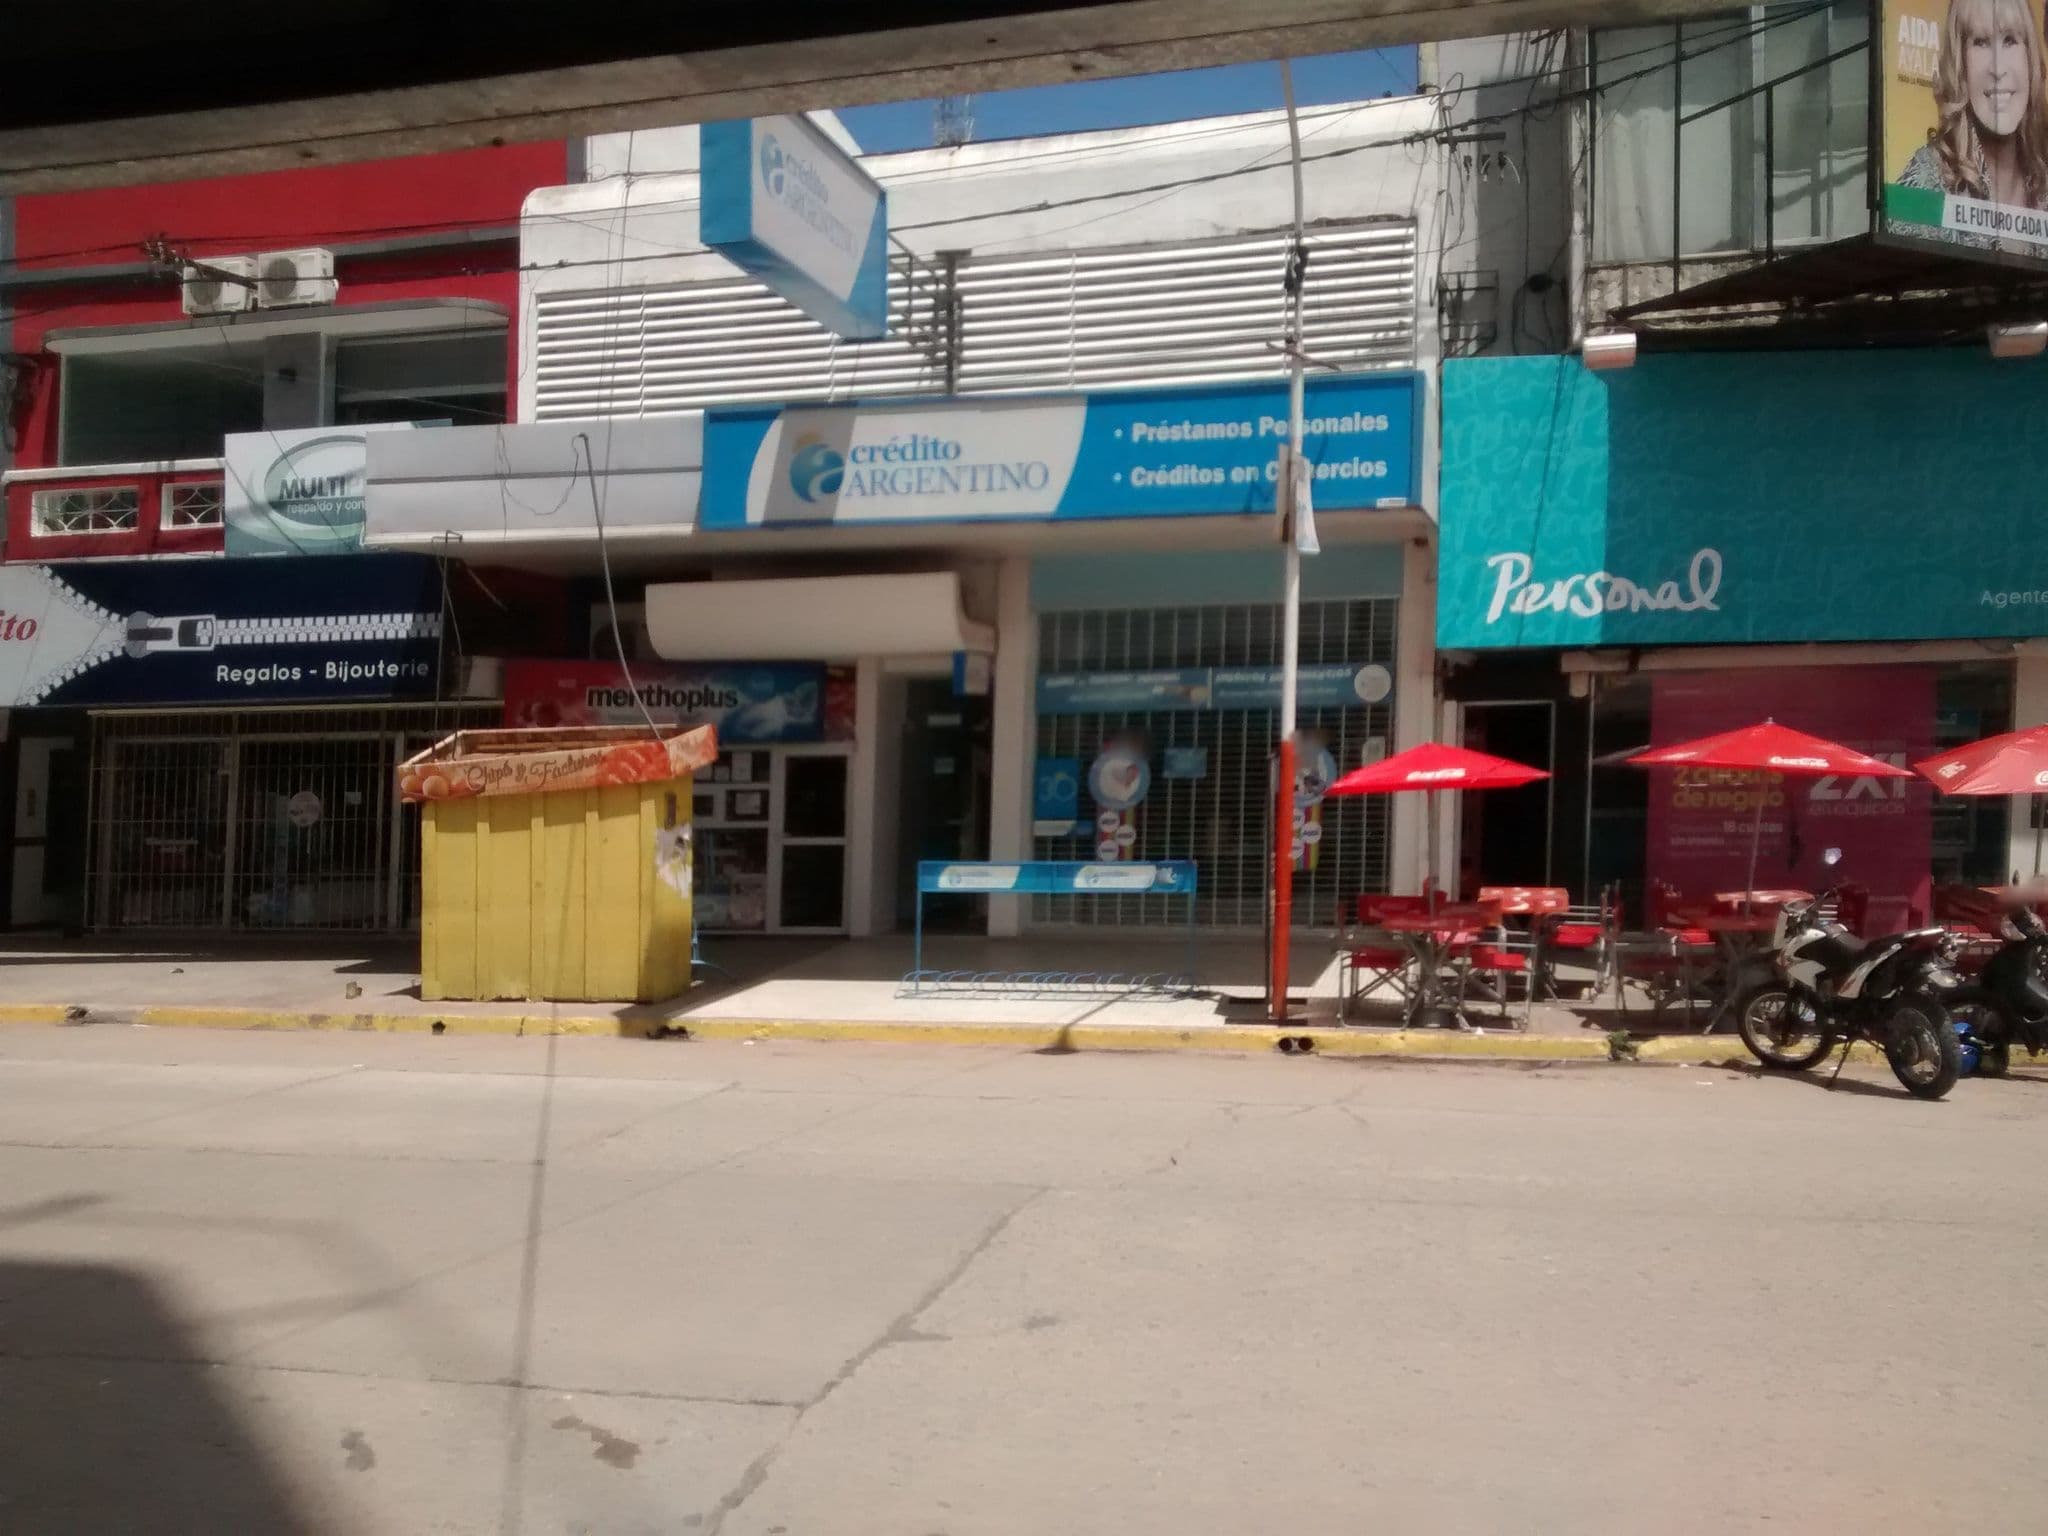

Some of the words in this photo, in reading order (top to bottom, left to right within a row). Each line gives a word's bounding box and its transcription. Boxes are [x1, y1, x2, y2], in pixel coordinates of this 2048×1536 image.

[1898, 14, 1940, 52] AIDA
[1955, 204, 1968, 224] EL
[1970, 206, 2013, 232] FUTURO
[2015, 215, 2043, 237] CADA
[1132, 419, 1253, 443] Préstamos
[1259, 411, 1389, 436] Pesonales
[851, 433, 961, 464] crédito
[846, 460, 1049, 497] ARGENTINO
[1131, 463, 1225, 487] Créditos
[1231, 464, 1259, 483] en
[1265, 456, 1387, 481] Cercios
[287, 500, 333, 515] respaldo
[335, 501, 342, 515] y
[1486, 548, 1723, 624] Personal
[216, 664, 302, 686] Regalos
[325, 658, 429, 682] Bijouterie
[587, 684, 739, 712] menthoplus
